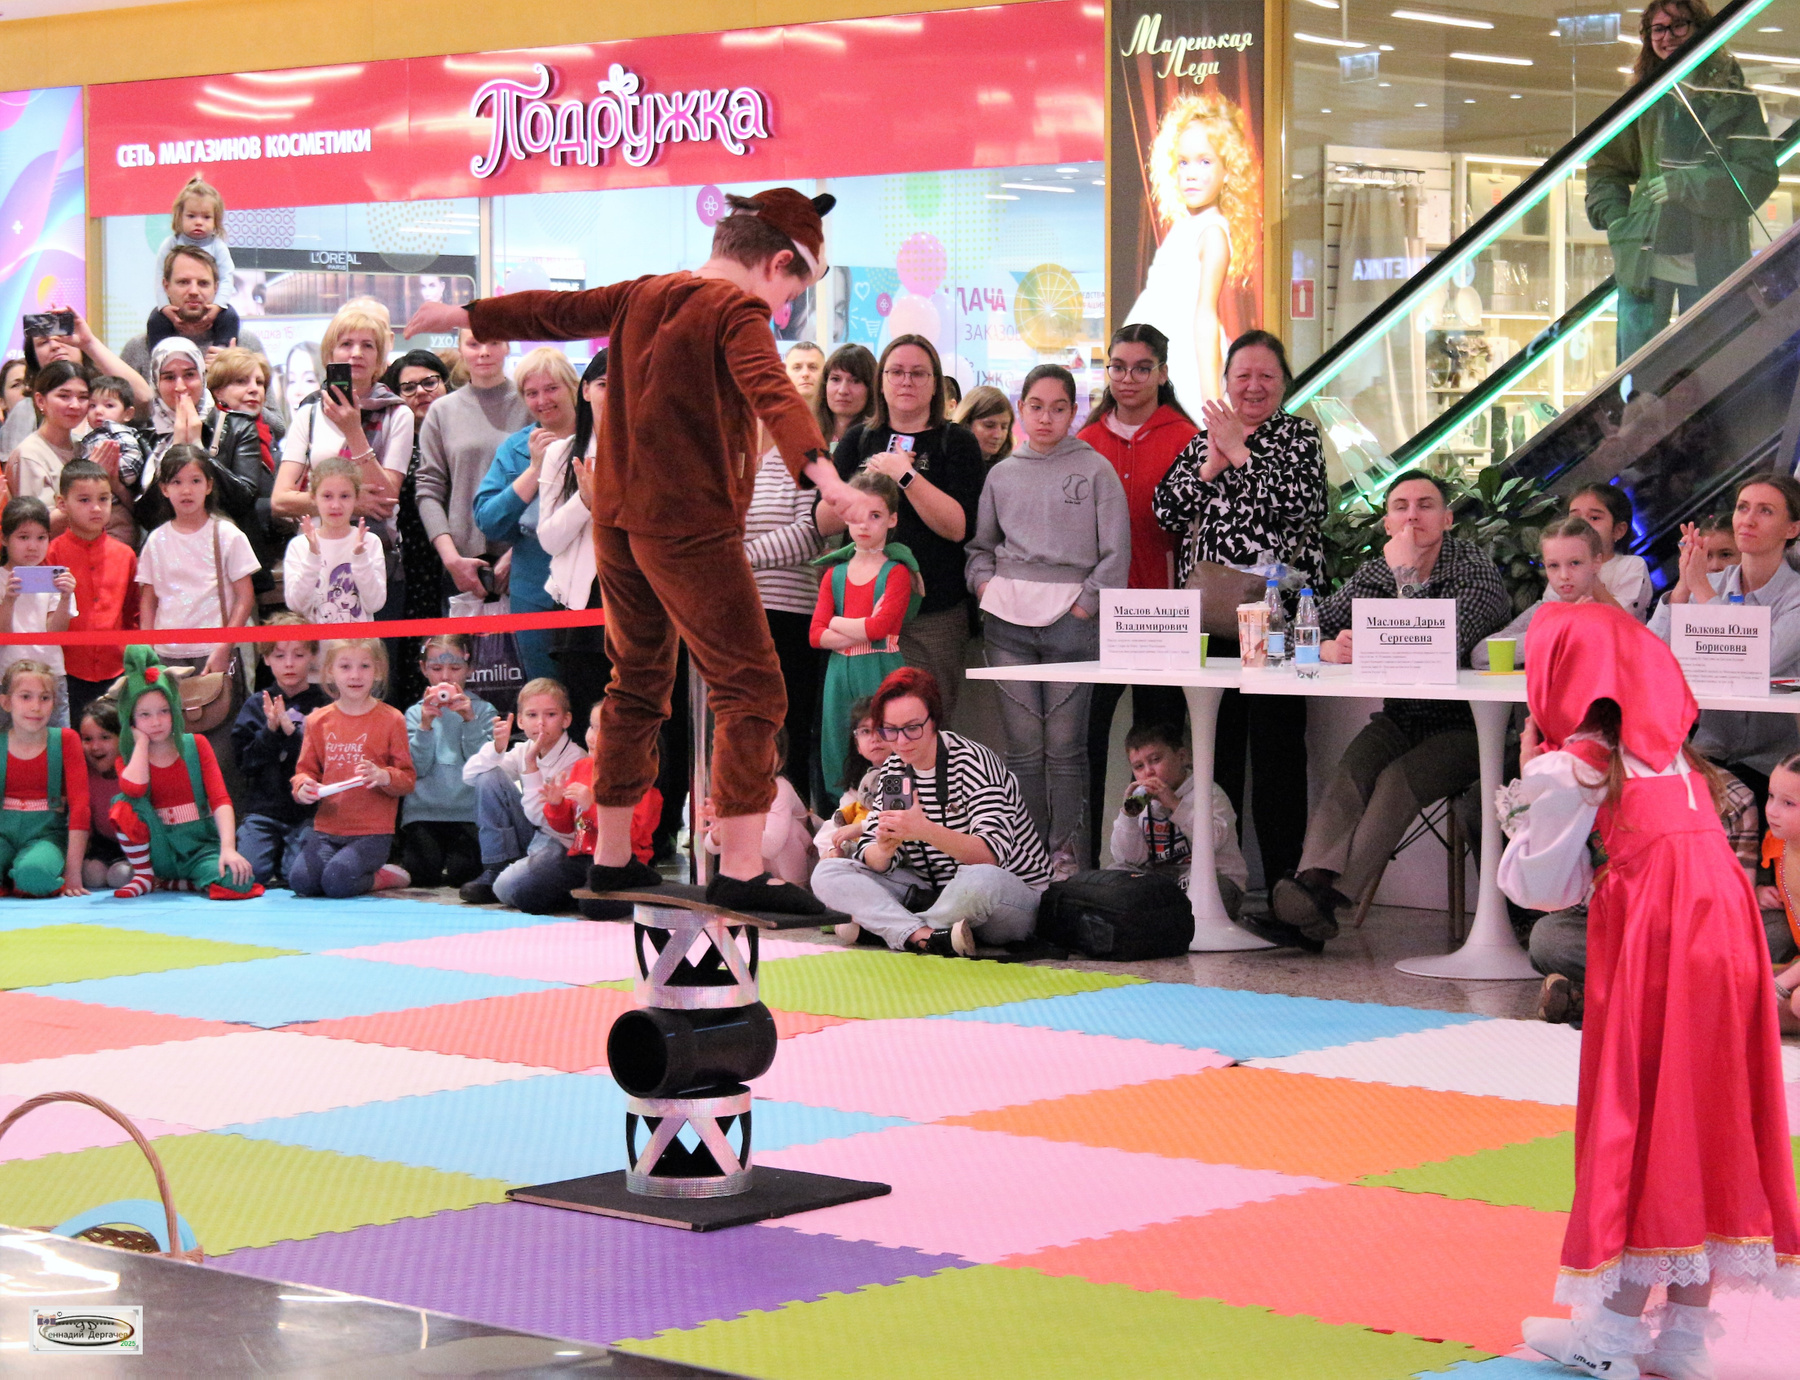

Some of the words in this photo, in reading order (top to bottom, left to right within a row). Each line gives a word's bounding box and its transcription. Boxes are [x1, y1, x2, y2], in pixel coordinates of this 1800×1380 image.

[1121, 13, 1253, 57] Маленькая
[1157, 36, 1220, 84] Леди
[470, 63, 768, 179] Подружка
[117, 144, 155, 167] СЕТЬ
[158, 136, 261, 165] МАГАЗИНОВ
[265, 128, 371, 158] КОСМЕТИКИ
[1114, 606, 1151, 616] Маслов
[1154, 606, 1190, 617] Андрей
[1115, 621, 1188, 632] Владимирович
[1367, 617, 1411, 627] Маслова
[1413, 617, 1445, 628] Дарья
[1685, 623, 1725, 635] Волкова
[1728, 624, 1758, 636] Юлия
[1380, 632, 1432, 644] Сергеевна
[1695, 641, 1747, 653] Борисовна
[466, 663, 522, 682] amilia
[325, 742, 364, 752] FUTURE
